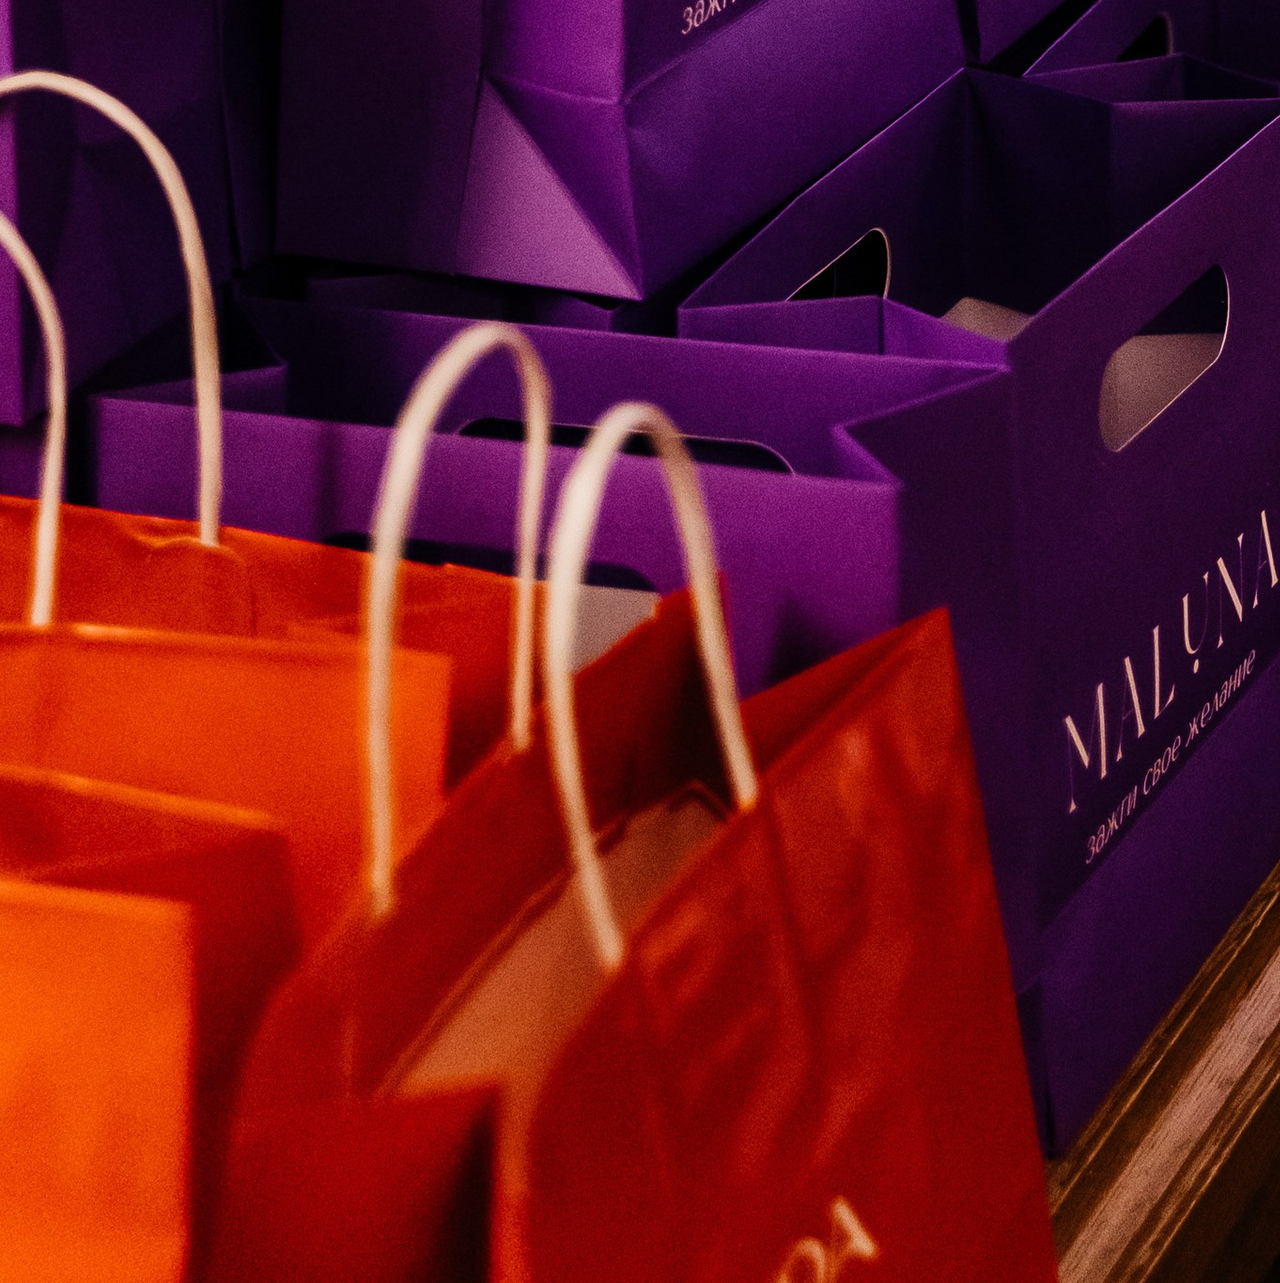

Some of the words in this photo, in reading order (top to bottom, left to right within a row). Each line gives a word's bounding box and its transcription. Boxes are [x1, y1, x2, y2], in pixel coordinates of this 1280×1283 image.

[1065, 509, 1279, 814] MALUNA
[1085, 785, 1138, 864] зажги
[1143, 735, 1181, 796] свое
[1185, 648, 1257, 748] желание
